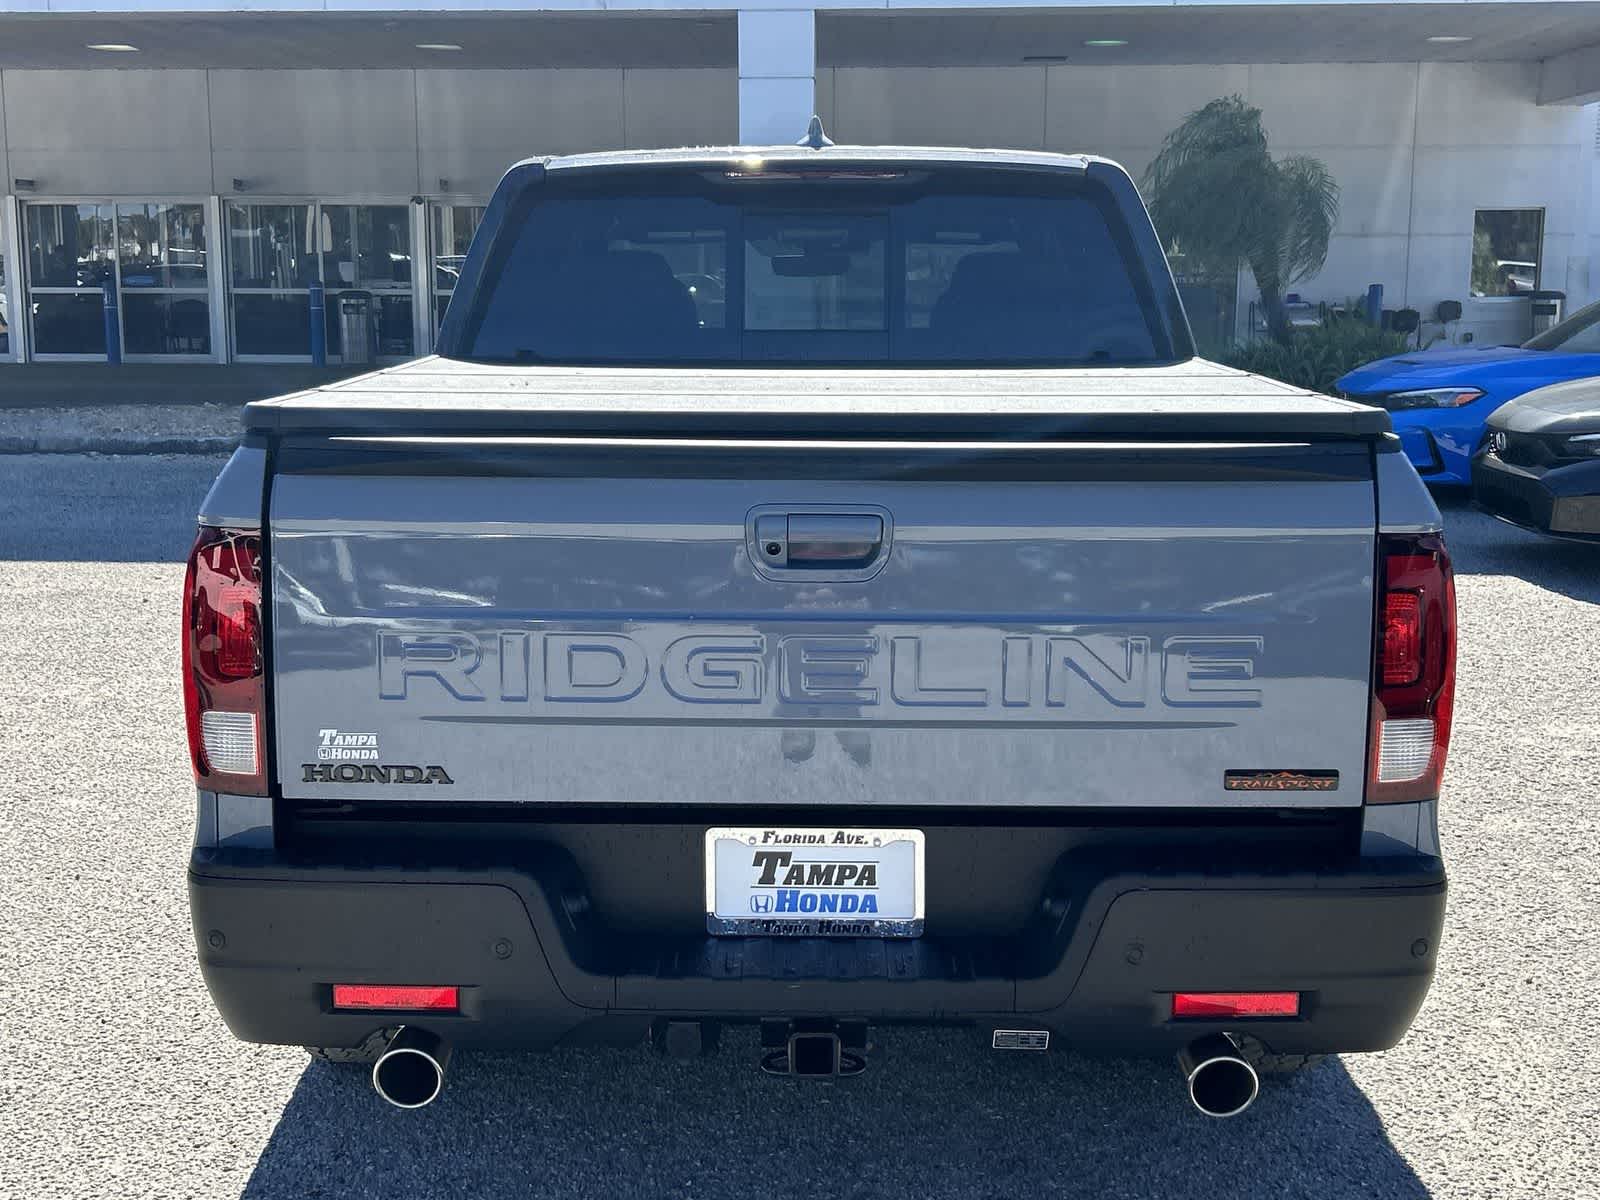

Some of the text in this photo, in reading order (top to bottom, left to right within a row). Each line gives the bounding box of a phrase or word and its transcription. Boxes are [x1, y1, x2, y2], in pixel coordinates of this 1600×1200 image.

[377, 629, 1265, 708] RIDGELINE
[319, 728, 378, 746] TAMPA
[331, 748, 379, 760] HONDA
[301, 763, 455, 785] HONDA
[1229, 779, 1336, 790] TRAILSPORT
[762, 831, 826, 845] FLORIDA
[752, 851, 877, 887] TAMPA
[774, 890, 879, 914] HONDA
